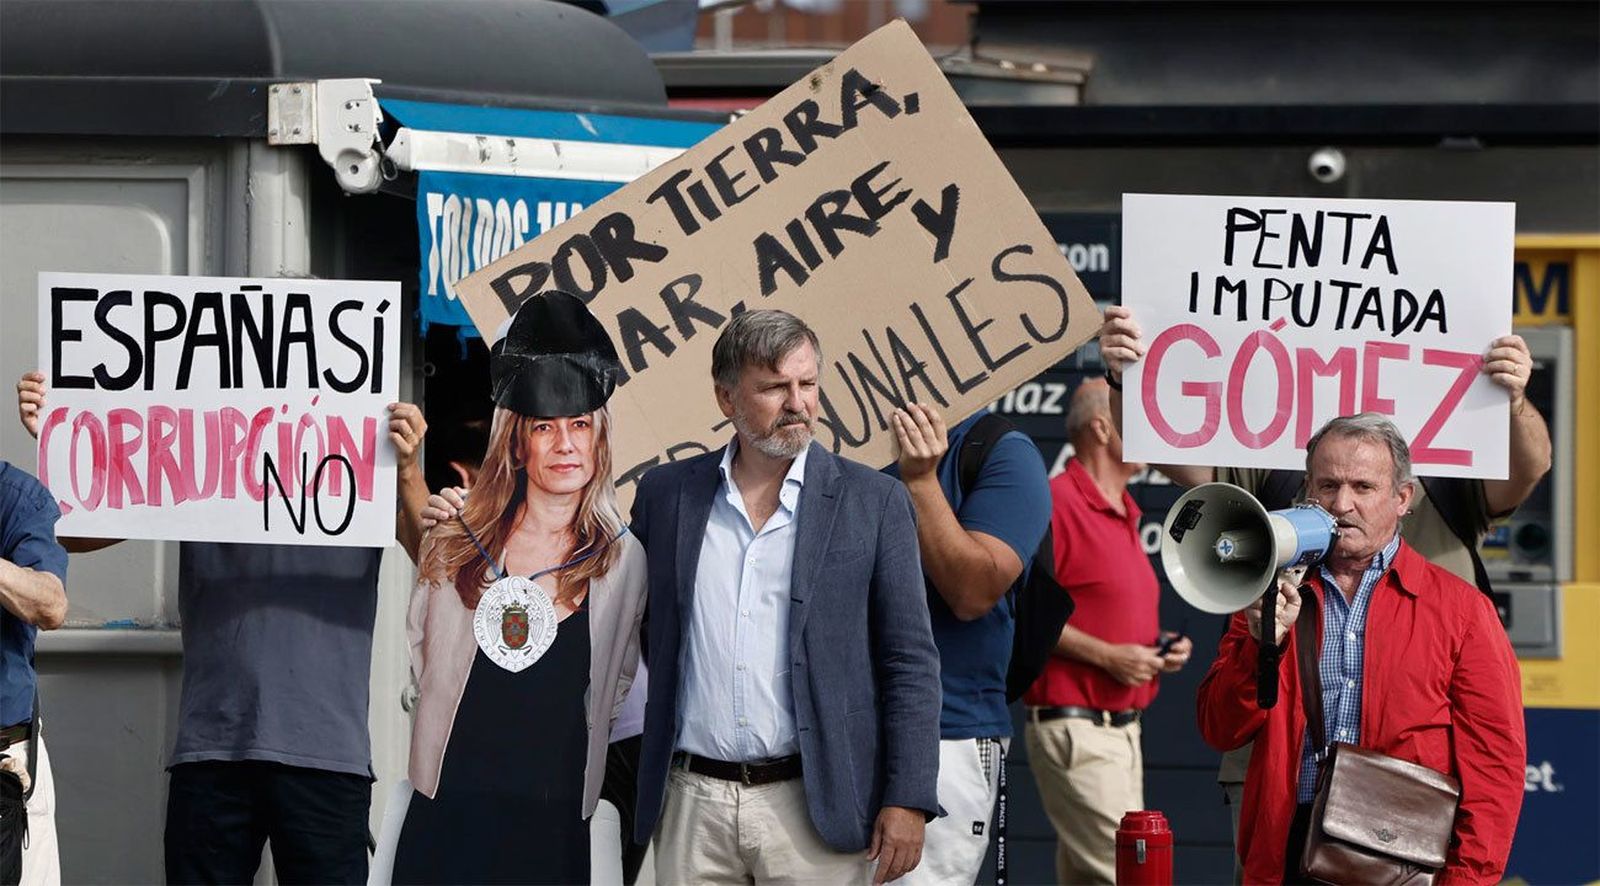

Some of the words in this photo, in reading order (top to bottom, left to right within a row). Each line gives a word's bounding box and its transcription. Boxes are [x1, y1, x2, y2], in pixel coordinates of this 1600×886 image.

[489, 211, 669, 318] POR
[647, 67, 920, 238] TIERRA,
[1223, 207, 1398, 275] PENTA
[605, 273, 747, 388] AR,
[753, 160, 914, 298] AIRE
[1188, 271, 1448, 337] IMPUTADA
[50, 285, 320, 392] ESPAÑA
[322, 298, 391, 395] SÍ
[1141, 316, 1486, 468] GÓMEZ
[263, 451, 357, 536] NO
